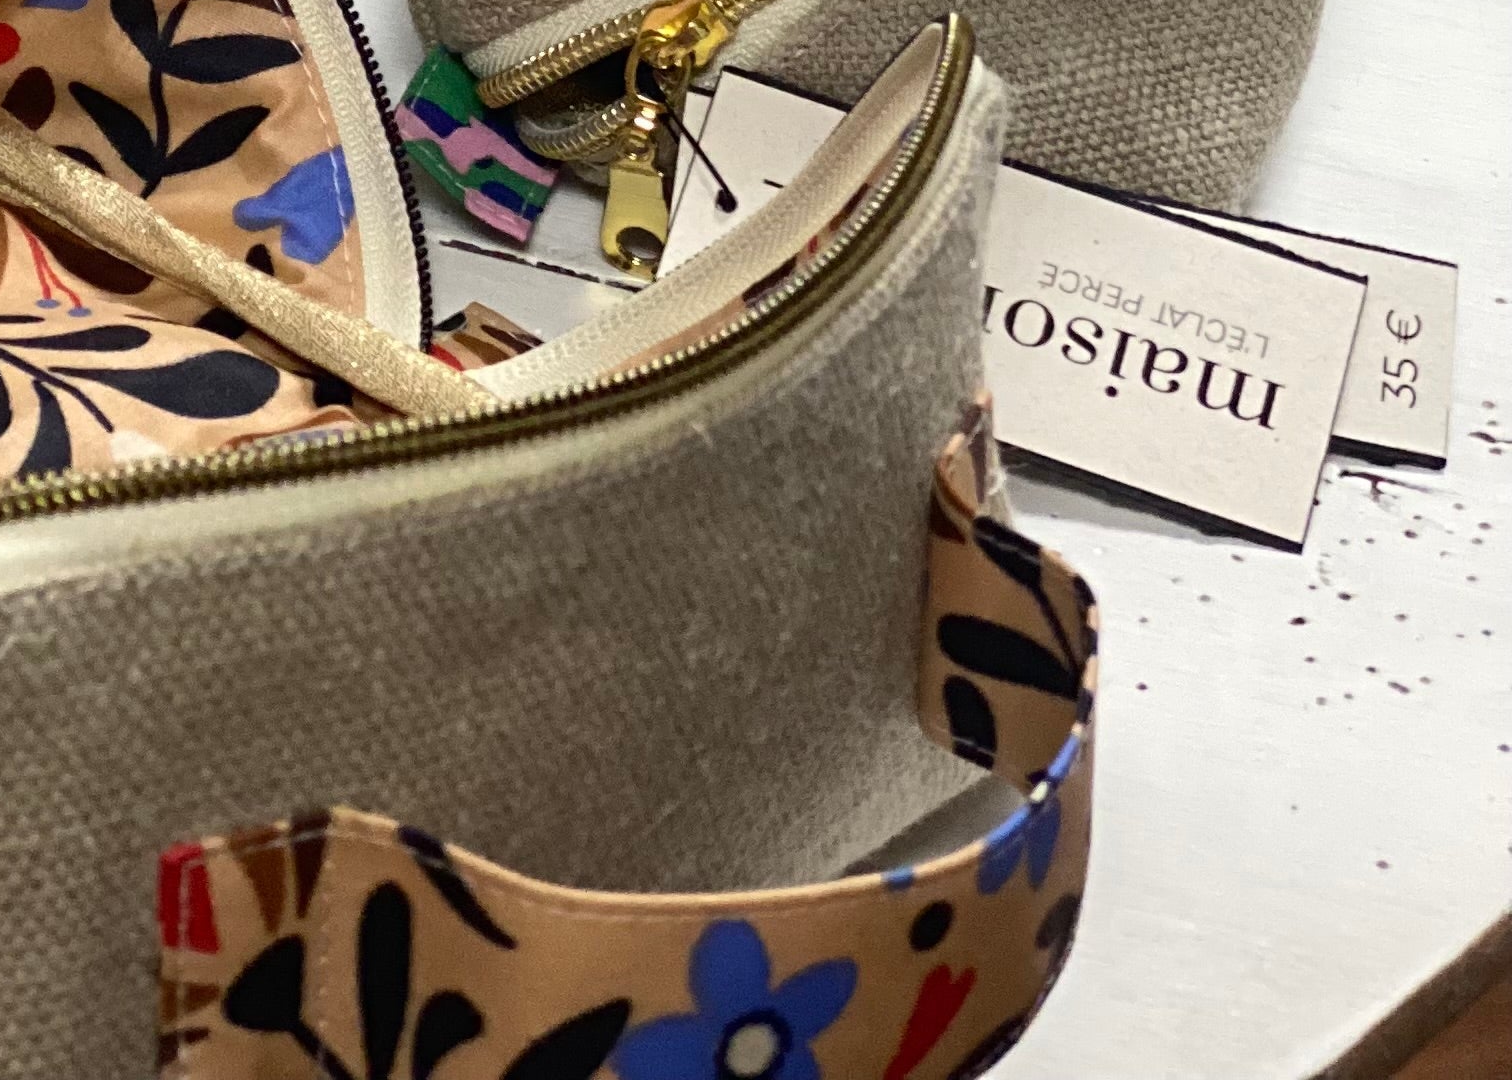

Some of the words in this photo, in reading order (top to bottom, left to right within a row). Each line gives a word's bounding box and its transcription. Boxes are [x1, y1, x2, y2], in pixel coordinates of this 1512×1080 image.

[1037, 261, 1144, 317] PERCÉ
[1150, 301, 1271, 360] L'ÉCLAT
[1385, 309, 1422, 345] €
[1381, 355, 1420, 409] 35
